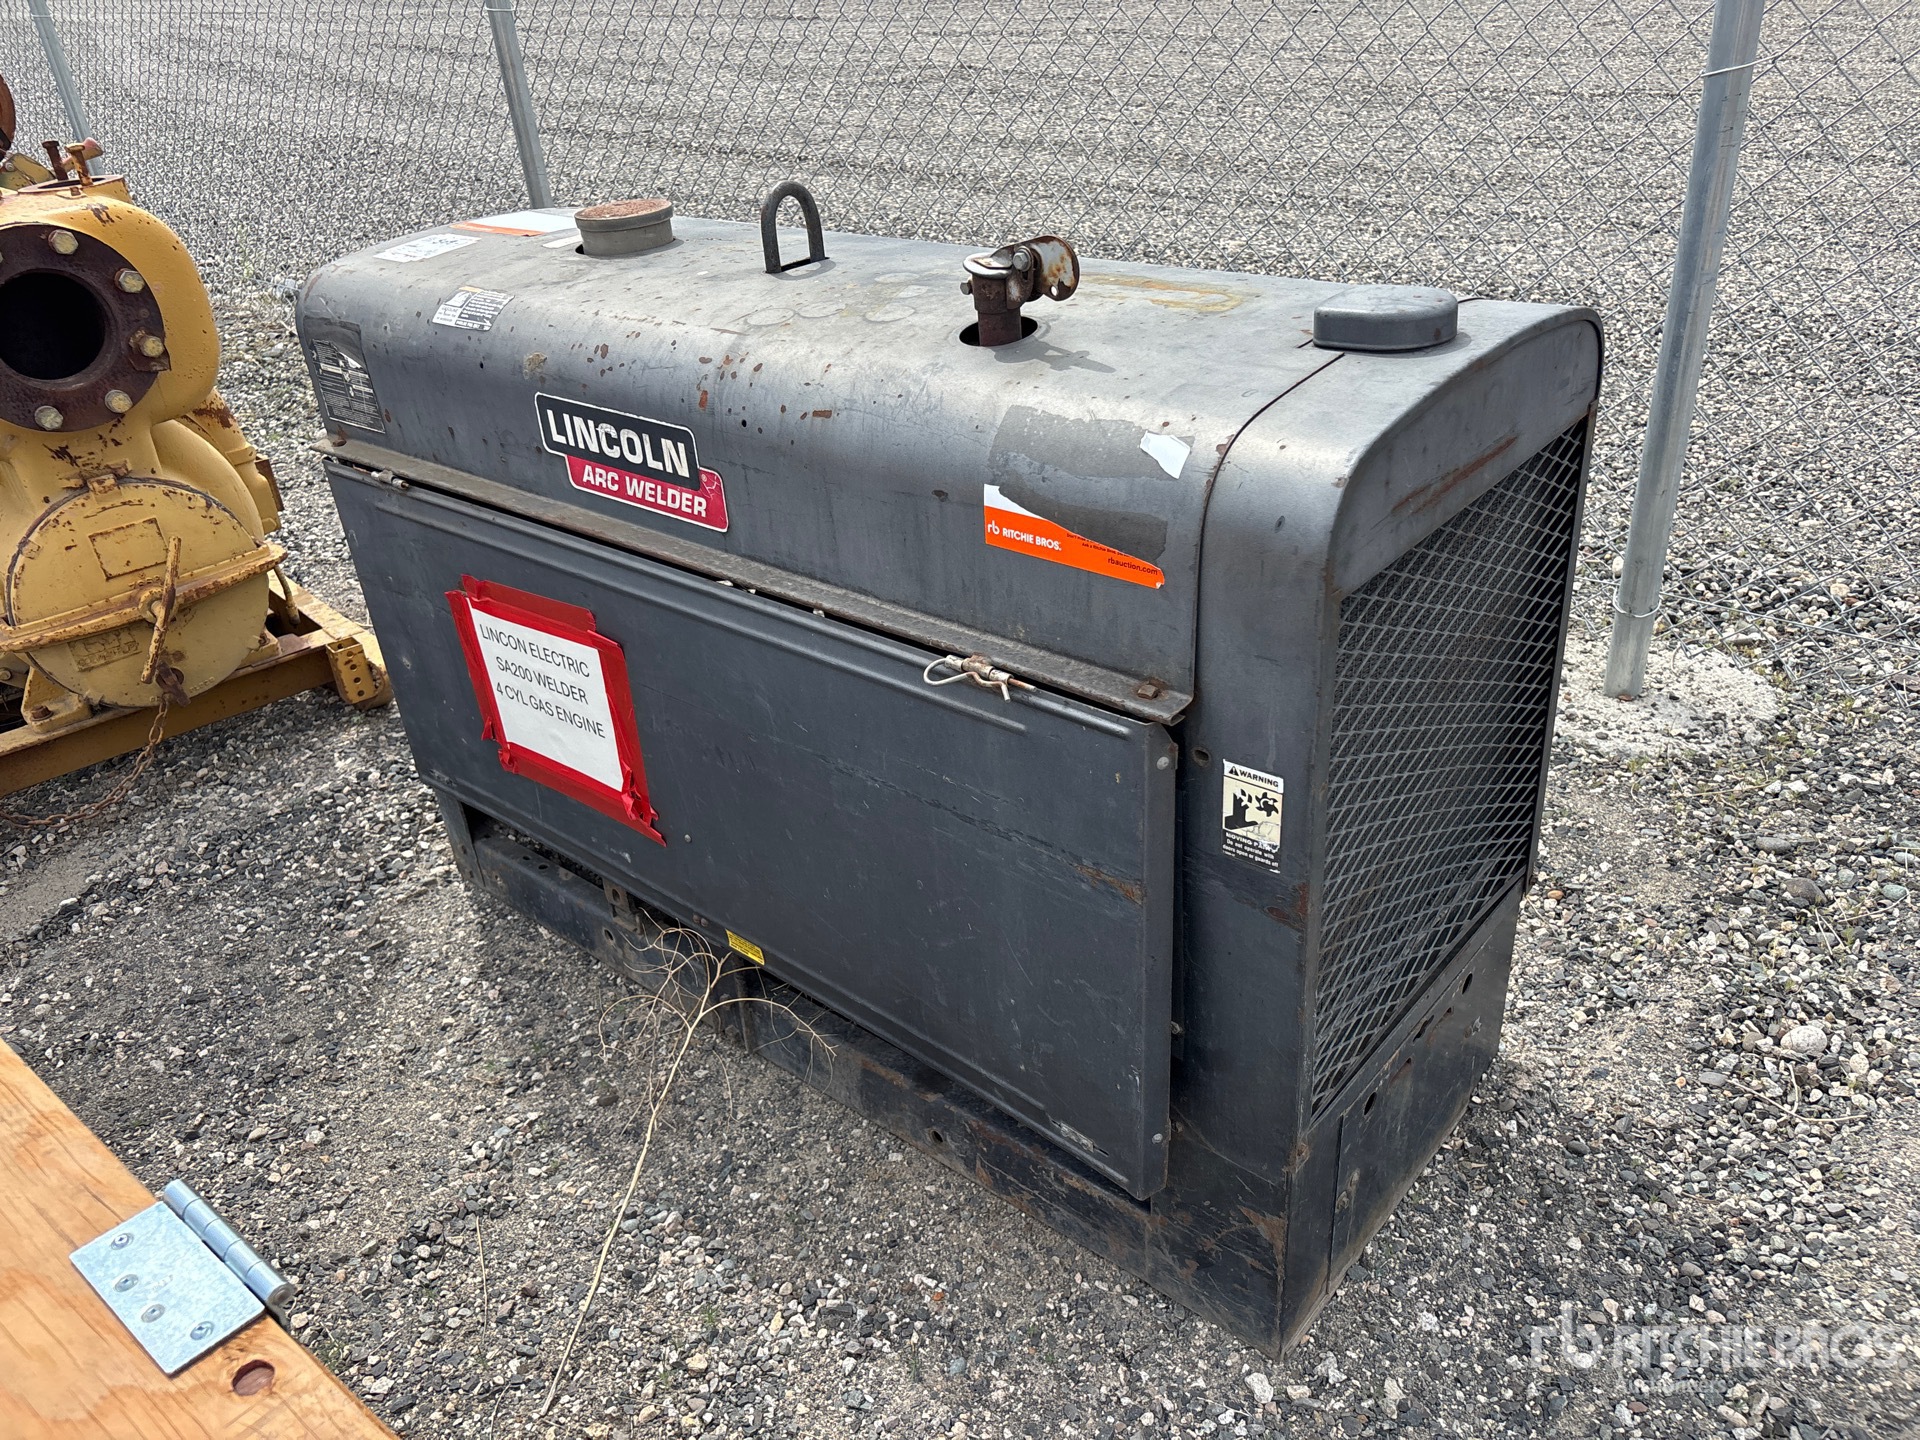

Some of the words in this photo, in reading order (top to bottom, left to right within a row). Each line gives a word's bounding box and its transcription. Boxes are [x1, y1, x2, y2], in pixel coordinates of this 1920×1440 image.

[546, 408, 690, 479] LINCOLN
[582, 464, 619, 491] ARC
[624, 475, 707, 518] WELDER
[987, 519, 1000, 535] rb
[1002, 527, 1035, 545] RITCHIE
[1035, 534, 1062, 551] BROS.
[1107, 556, 1158, 576] rbauction.com
[479, 623, 527, 655] LINCON
[529, 641, 590, 678] ELECTRIC
[495, 655, 533, 683] SA200
[533, 670, 589, 705] WELDER
[496, 682, 504, 696] 4
[504, 685, 529, 706] CYL
[529, 694, 555, 717] GAS
[555, 705, 606, 739] ENGINE
[1239, 769, 1279, 788] WARNING
